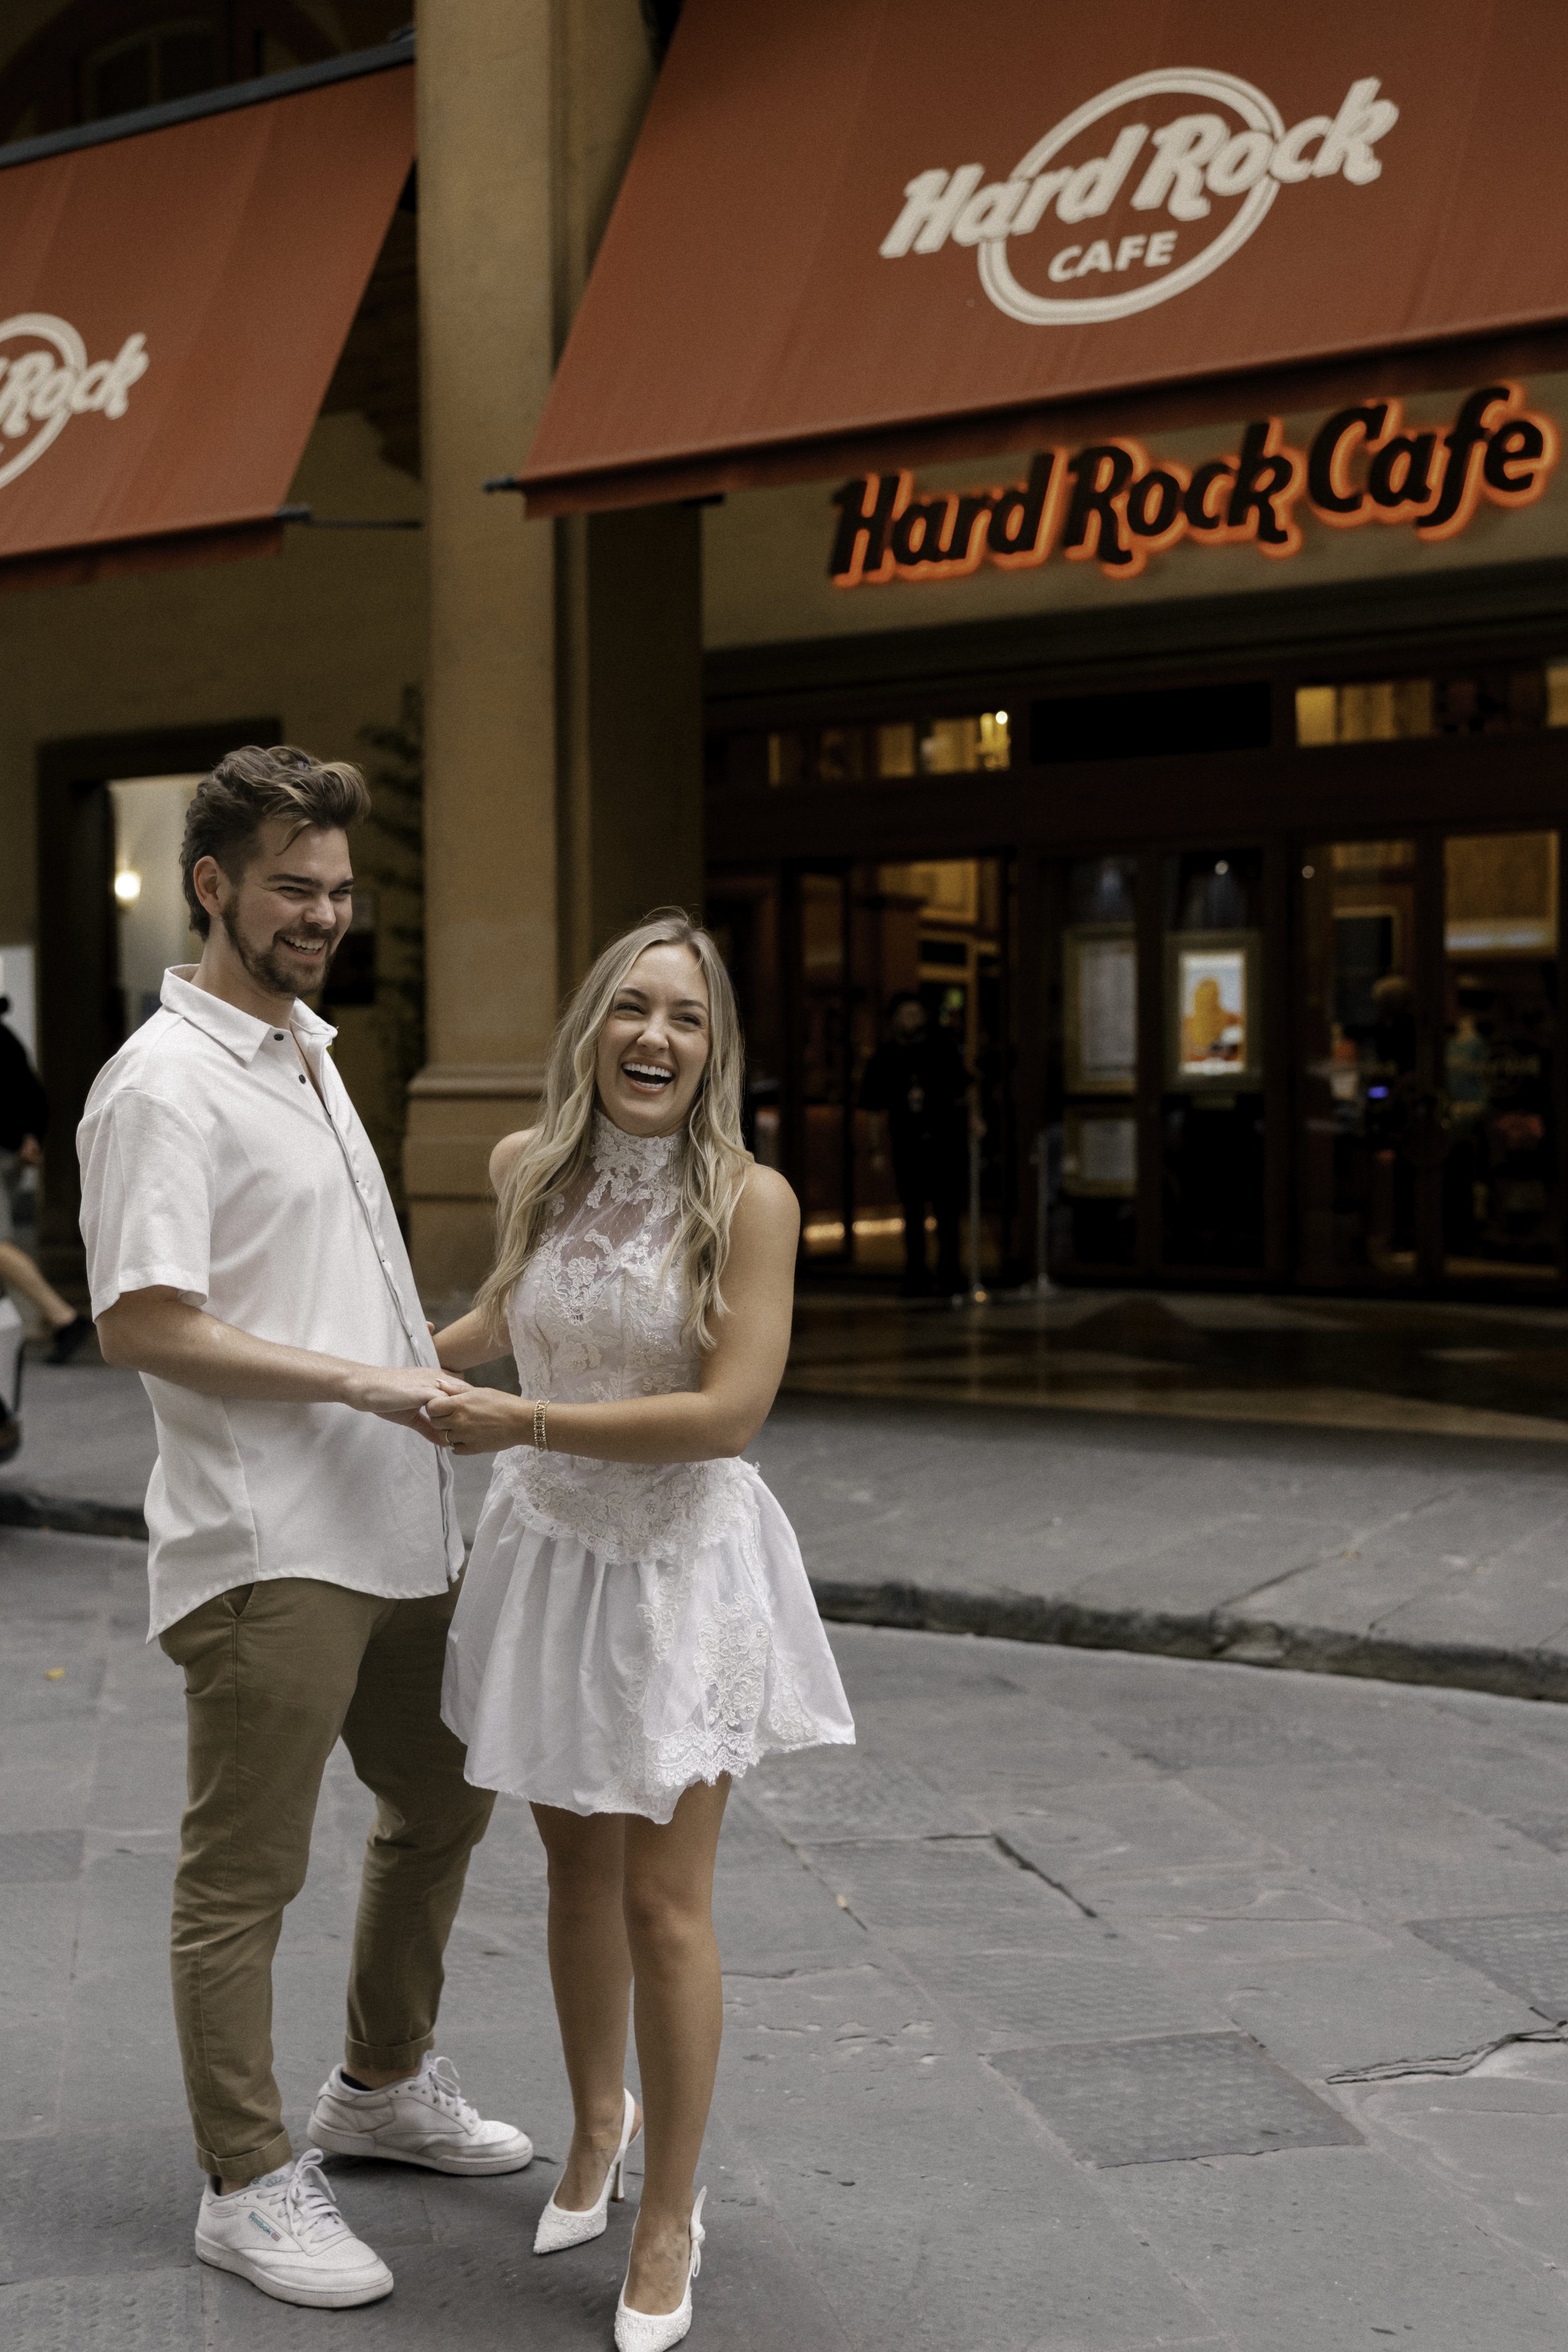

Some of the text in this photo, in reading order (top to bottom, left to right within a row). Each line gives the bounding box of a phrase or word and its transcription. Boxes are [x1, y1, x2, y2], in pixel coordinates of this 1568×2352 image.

[879, 76, 1400, 259] Hard Rock
[1047, 230, 1179, 283] CAFE
[0, 332, 151, 438] Rock
[829, 383, 1557, 586] Hard Rock Cafe
